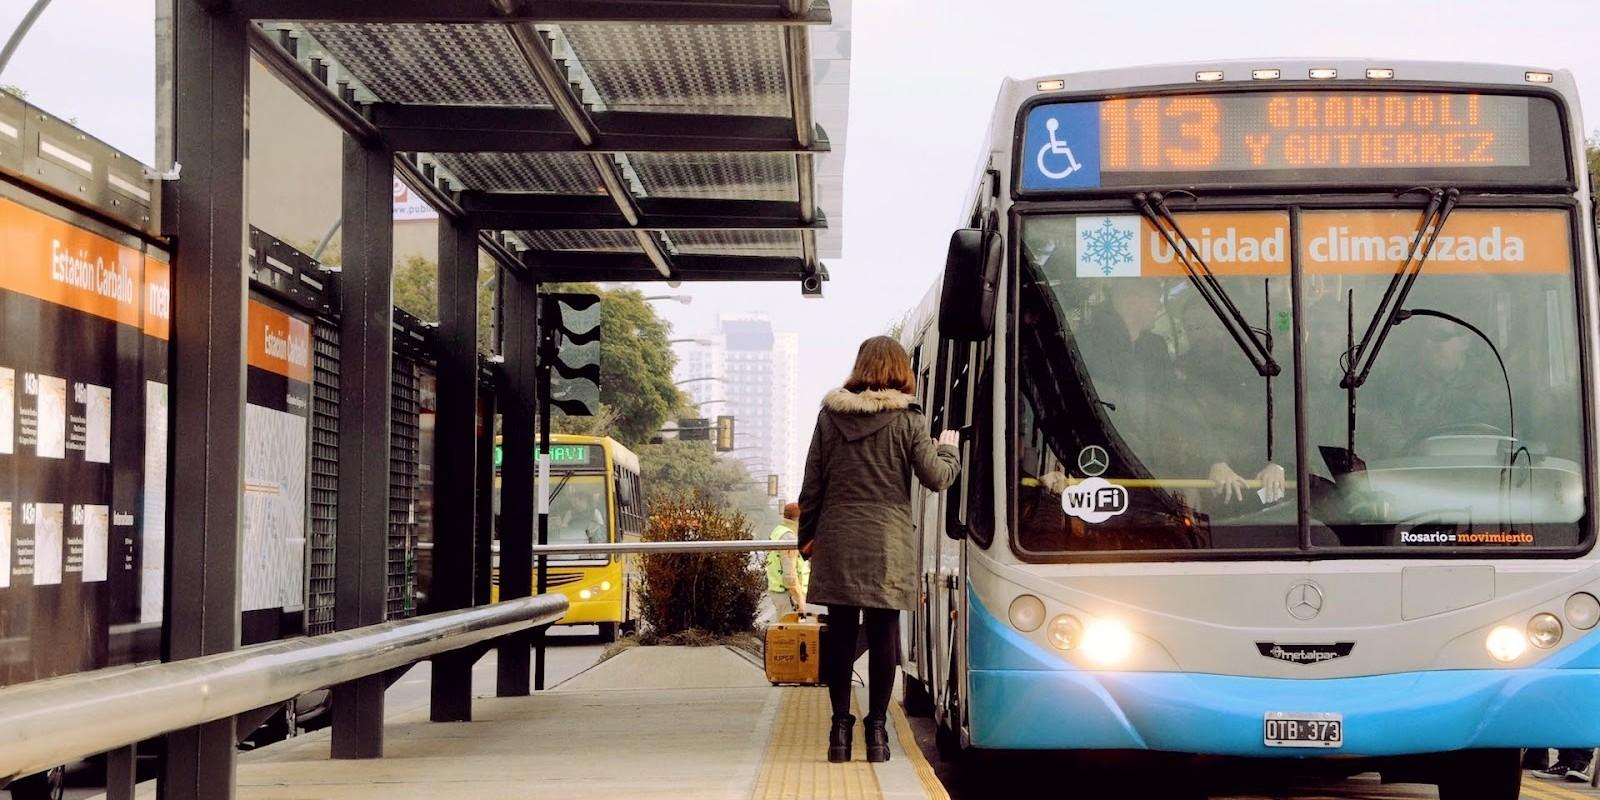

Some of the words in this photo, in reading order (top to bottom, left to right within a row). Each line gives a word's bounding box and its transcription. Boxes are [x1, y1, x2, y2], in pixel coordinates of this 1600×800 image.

[1268, 93, 1480, 129] GRANDOLI
[1101, 96, 1221, 166] 113
[1244, 134, 1271, 165] Y
[1284, 131, 1496, 165] GUTIERREZ
[1150, 227, 1285, 264] Unidad
[1308, 226, 1525, 263] climatizada
[52, 239, 95, 292] Estación
[96, 256, 133, 305] Carballo
[1280, 649, 1338, 661] metalpar
[1266, 720, 1299, 740] OTB
[1307, 720, 1340, 741] 373
